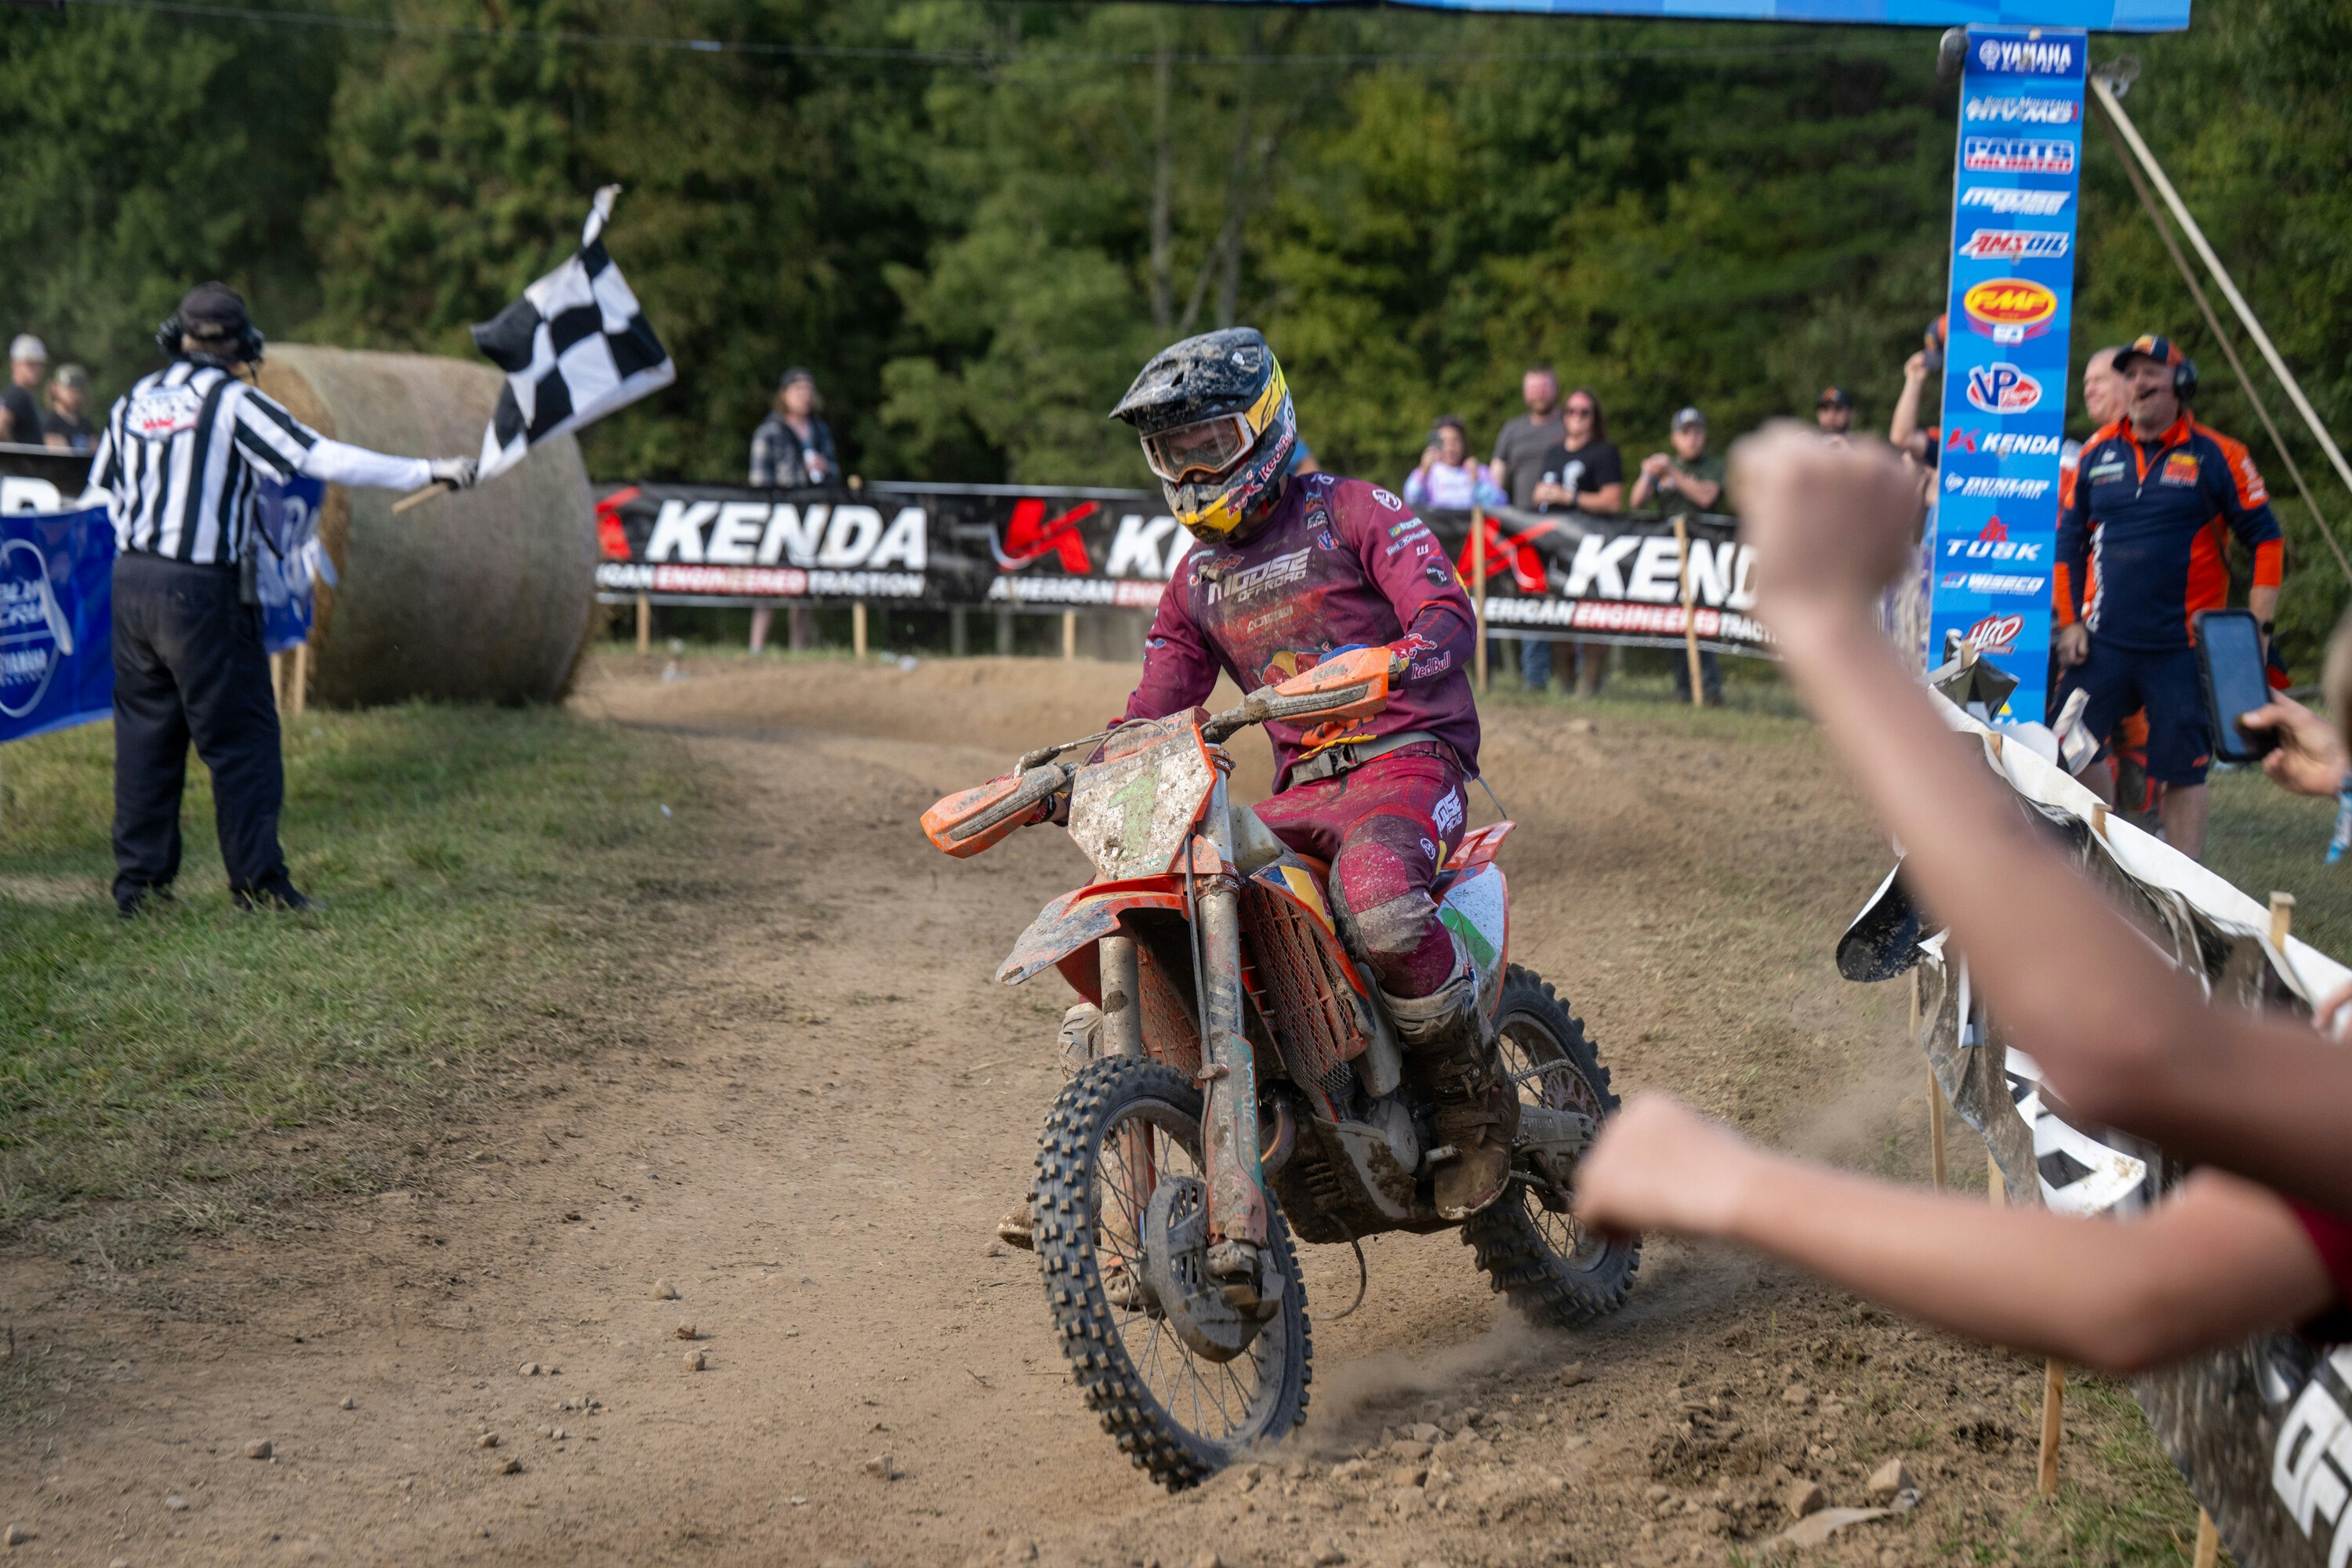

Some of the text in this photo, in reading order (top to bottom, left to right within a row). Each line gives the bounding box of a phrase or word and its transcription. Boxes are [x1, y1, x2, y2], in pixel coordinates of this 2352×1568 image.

[2002, 41, 2071, 68] YAMAHA
[1970, 289, 2049, 312] FMF
[1974, 369, 2018, 406] VP
[1981, 432, 2060, 456] KENDA
[645, 499, 927, 571] KENDA
[1947, 539, 2043, 561] TUSK
[657, 565, 806, 594] ENGINEERED
[808, 569, 926, 597] TRACTION
[988, 575, 1116, 604] AMERICAN
[1207, 546, 1312, 606] MOOSE
[1968, 572, 2045, 590] WISECO
[1411, 650, 1451, 681] Red Bull
[1109, 764, 1161, 860] 1
